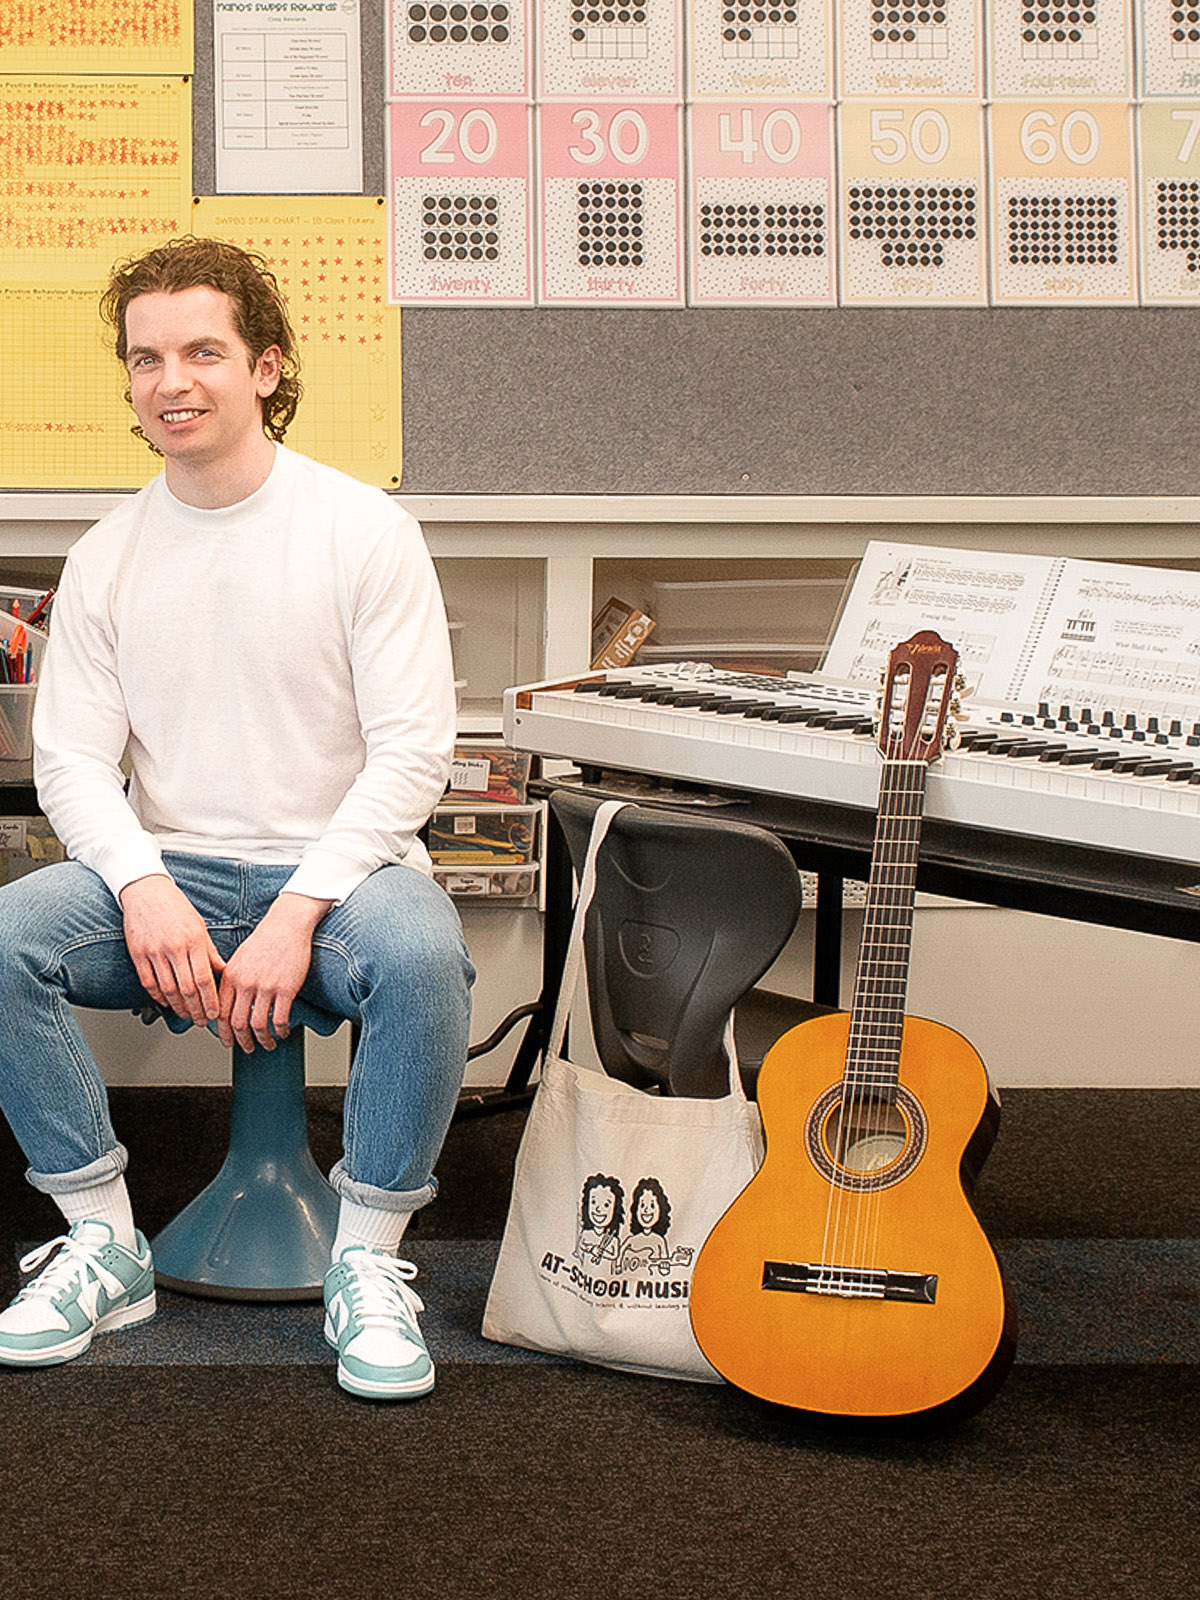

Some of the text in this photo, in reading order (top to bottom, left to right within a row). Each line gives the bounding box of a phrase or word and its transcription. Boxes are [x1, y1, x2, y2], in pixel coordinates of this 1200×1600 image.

[446, 74, 472, 88] ten
[582, 75, 636, 90] eleven
[419, 108, 499, 165] 20
[568, 108, 650, 165] 30
[718, 108, 800, 165] 40
[870, 108, 950, 165] 50
[1019, 108, 1100, 165] 60
[248, 216, 271, 226] STAR
[273, 216, 300, 226] CHART
[431, 277, 491, 293] twenty
[587, 277, 636, 293] thirty
[541, 1251, 630, 1298] AT-SCHOOL
